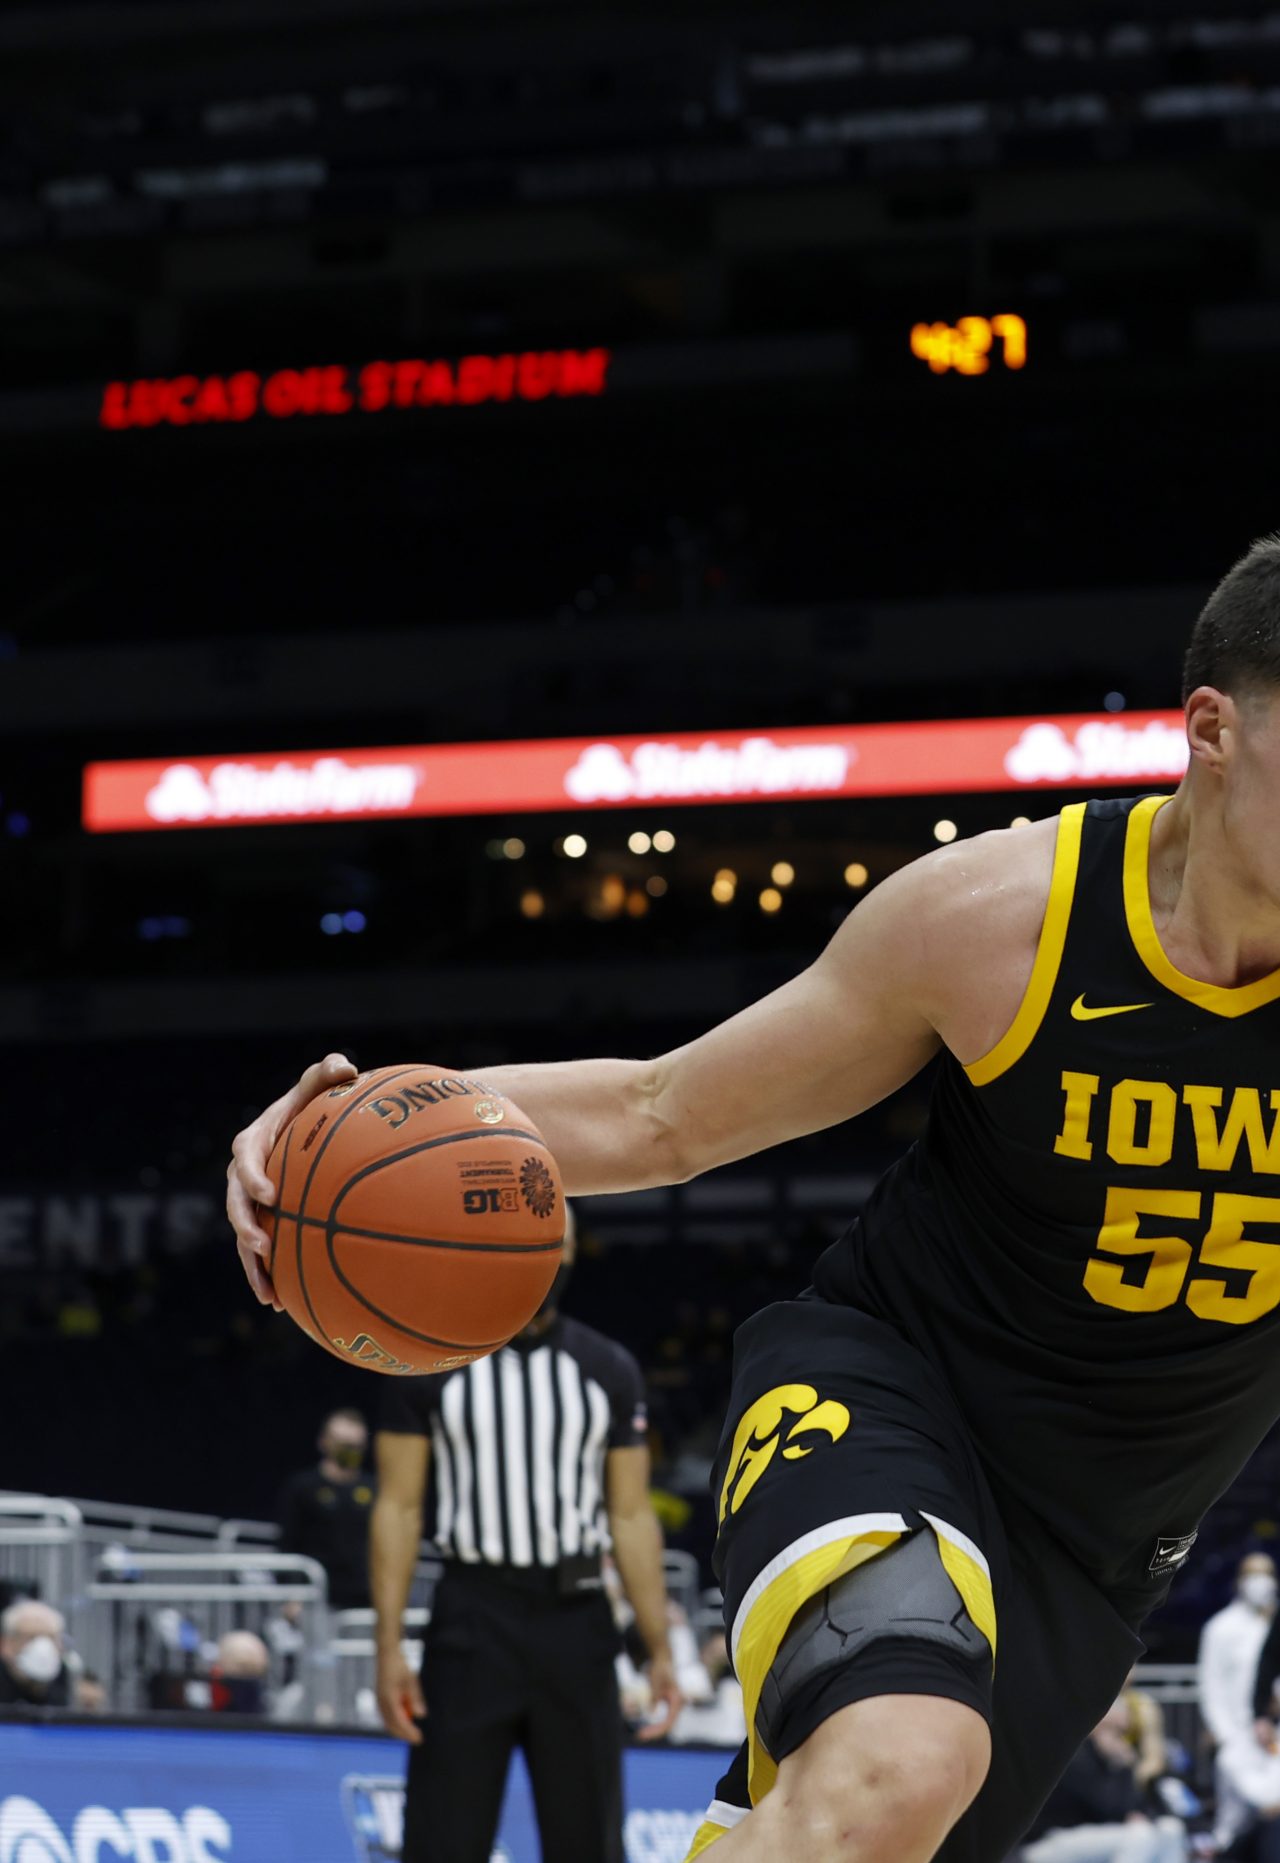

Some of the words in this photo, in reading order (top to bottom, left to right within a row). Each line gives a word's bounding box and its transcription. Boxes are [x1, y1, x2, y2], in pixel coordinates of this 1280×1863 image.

[100, 371, 260, 430] LUCAS
[264, 365, 352, 418] OIL
[358, 348, 609, 411] STADIUM
